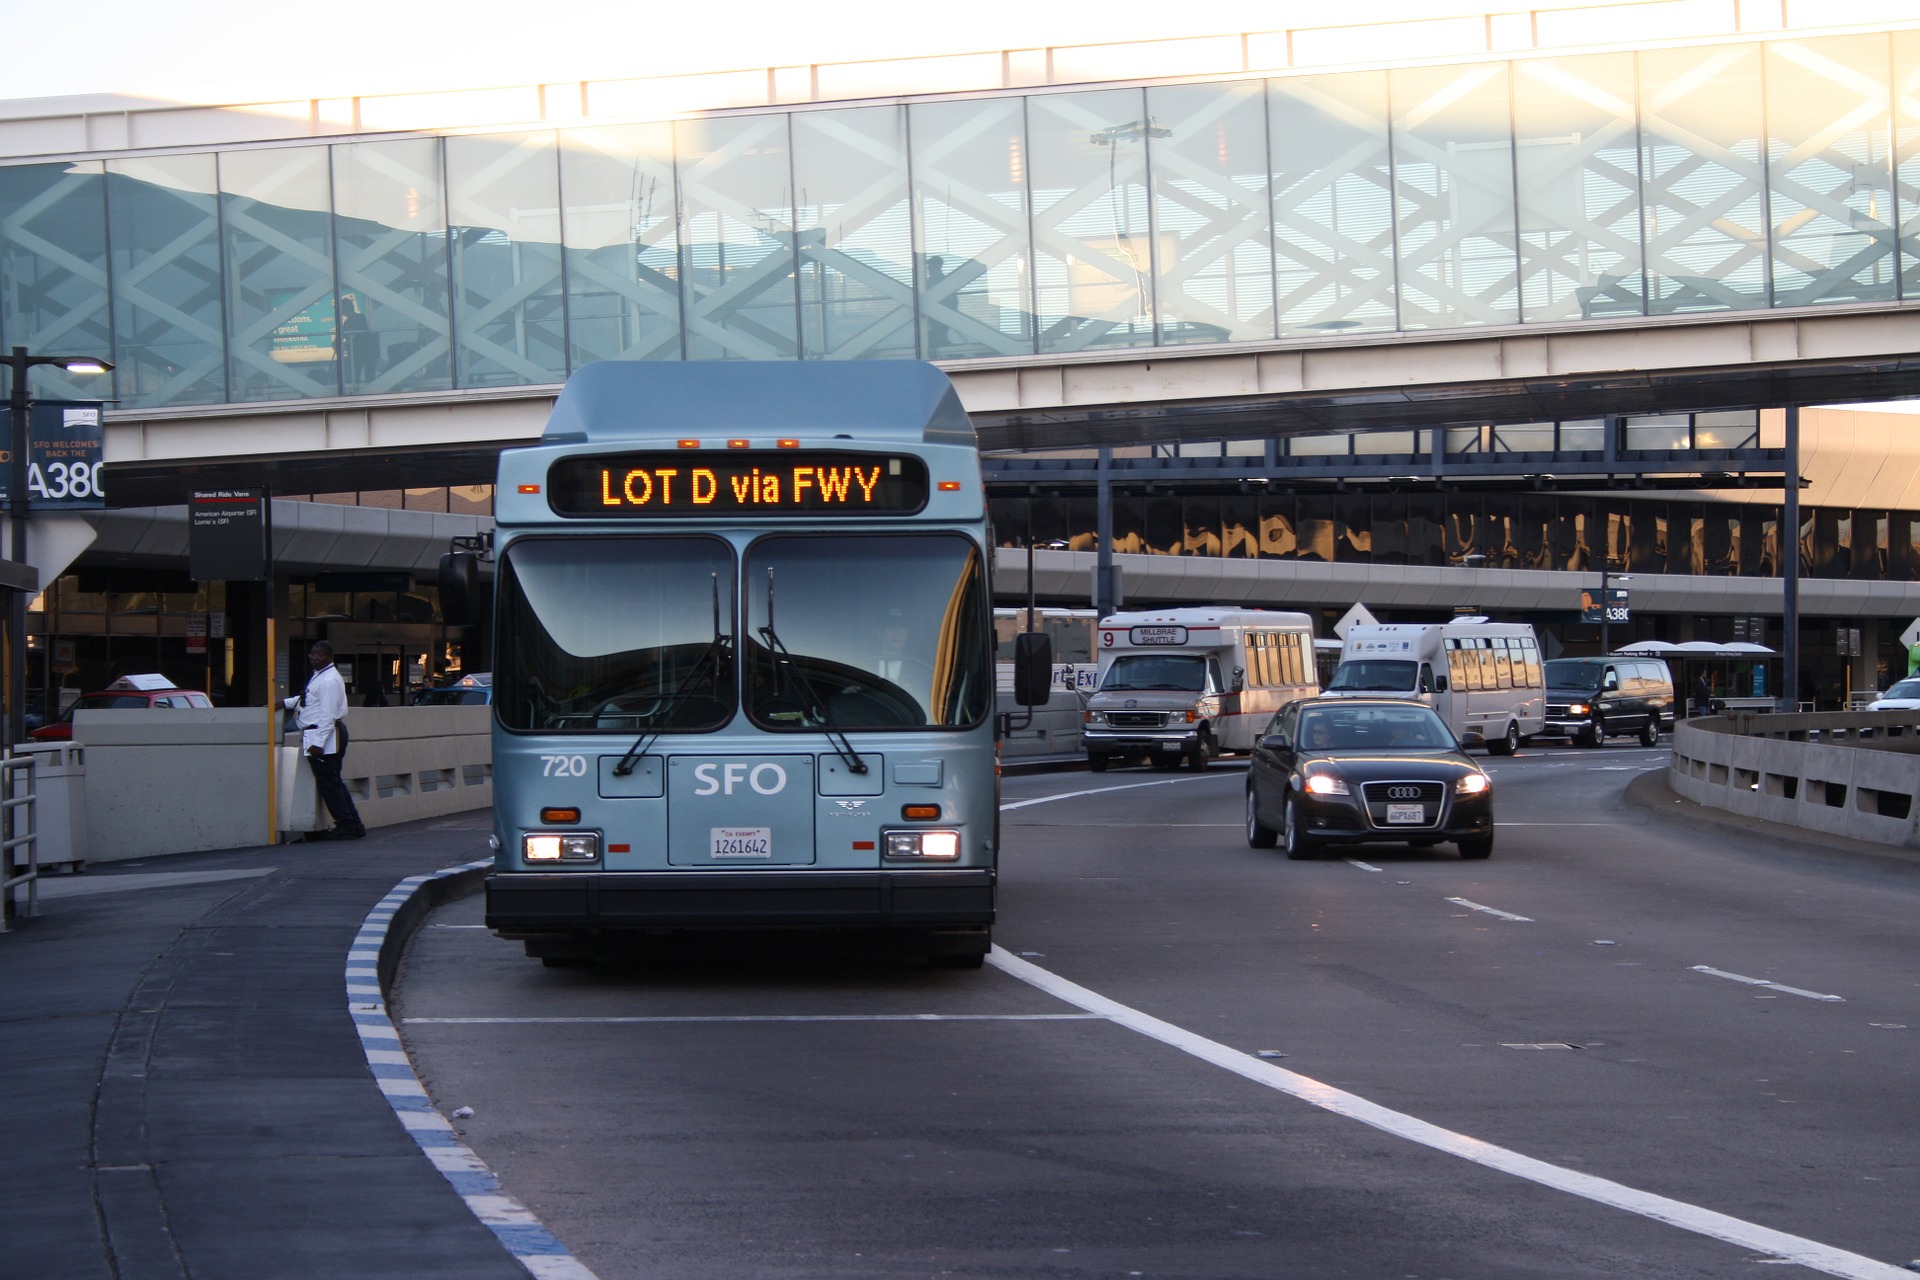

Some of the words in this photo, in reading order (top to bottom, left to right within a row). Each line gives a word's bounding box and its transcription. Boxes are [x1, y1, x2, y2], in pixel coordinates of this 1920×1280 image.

[278, 325, 299, 335] great
[33, 441, 50, 449] SFO
[52, 440, 98, 449] WELCOMES
[45, 450, 68, 458] BACK
[28, 461, 105, 499] A380
[602, 469, 678, 505] LOT
[692, 469, 718, 504] D
[731, 469, 780, 503] via
[794, 467, 881, 502] FWY
[1140, 628, 1177, 636] MILLBRAE
[1103, 632, 1115, 648] 9
[1142, 636, 1176, 644] SHUTTLE
[540, 755, 587, 777] 720
[694, 762, 787, 796] SFO
[715, 839, 767, 854] 1261642
